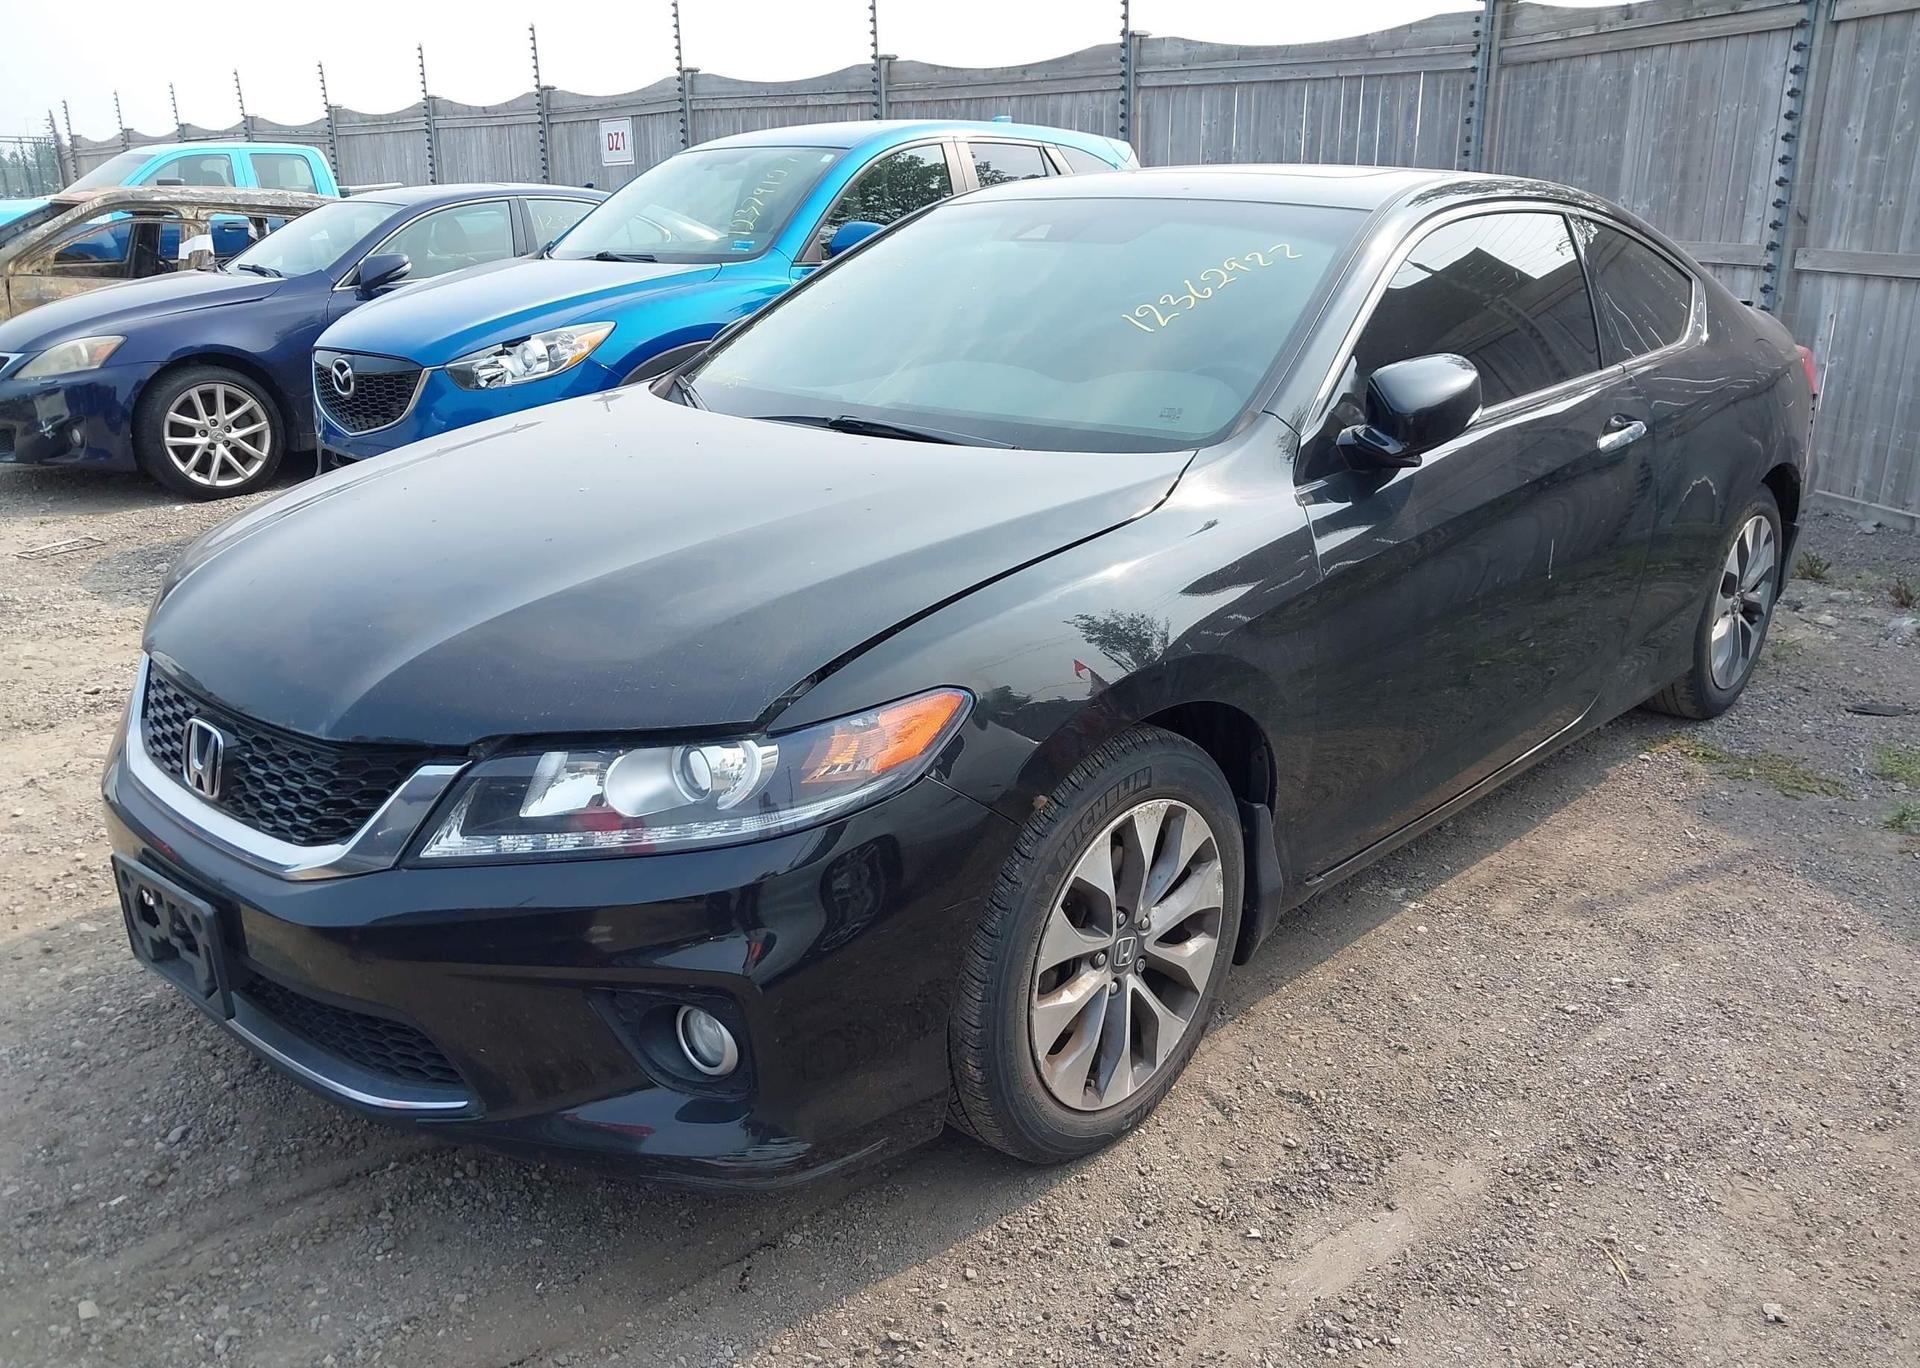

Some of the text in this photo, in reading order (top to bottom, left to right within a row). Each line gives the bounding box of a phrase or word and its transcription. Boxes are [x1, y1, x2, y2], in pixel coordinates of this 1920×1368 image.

[607, 131, 626, 151] DZ1
[1121, 243, 1303, 333] 12362922
[1056, 766, 1152, 870] MICHELIN
